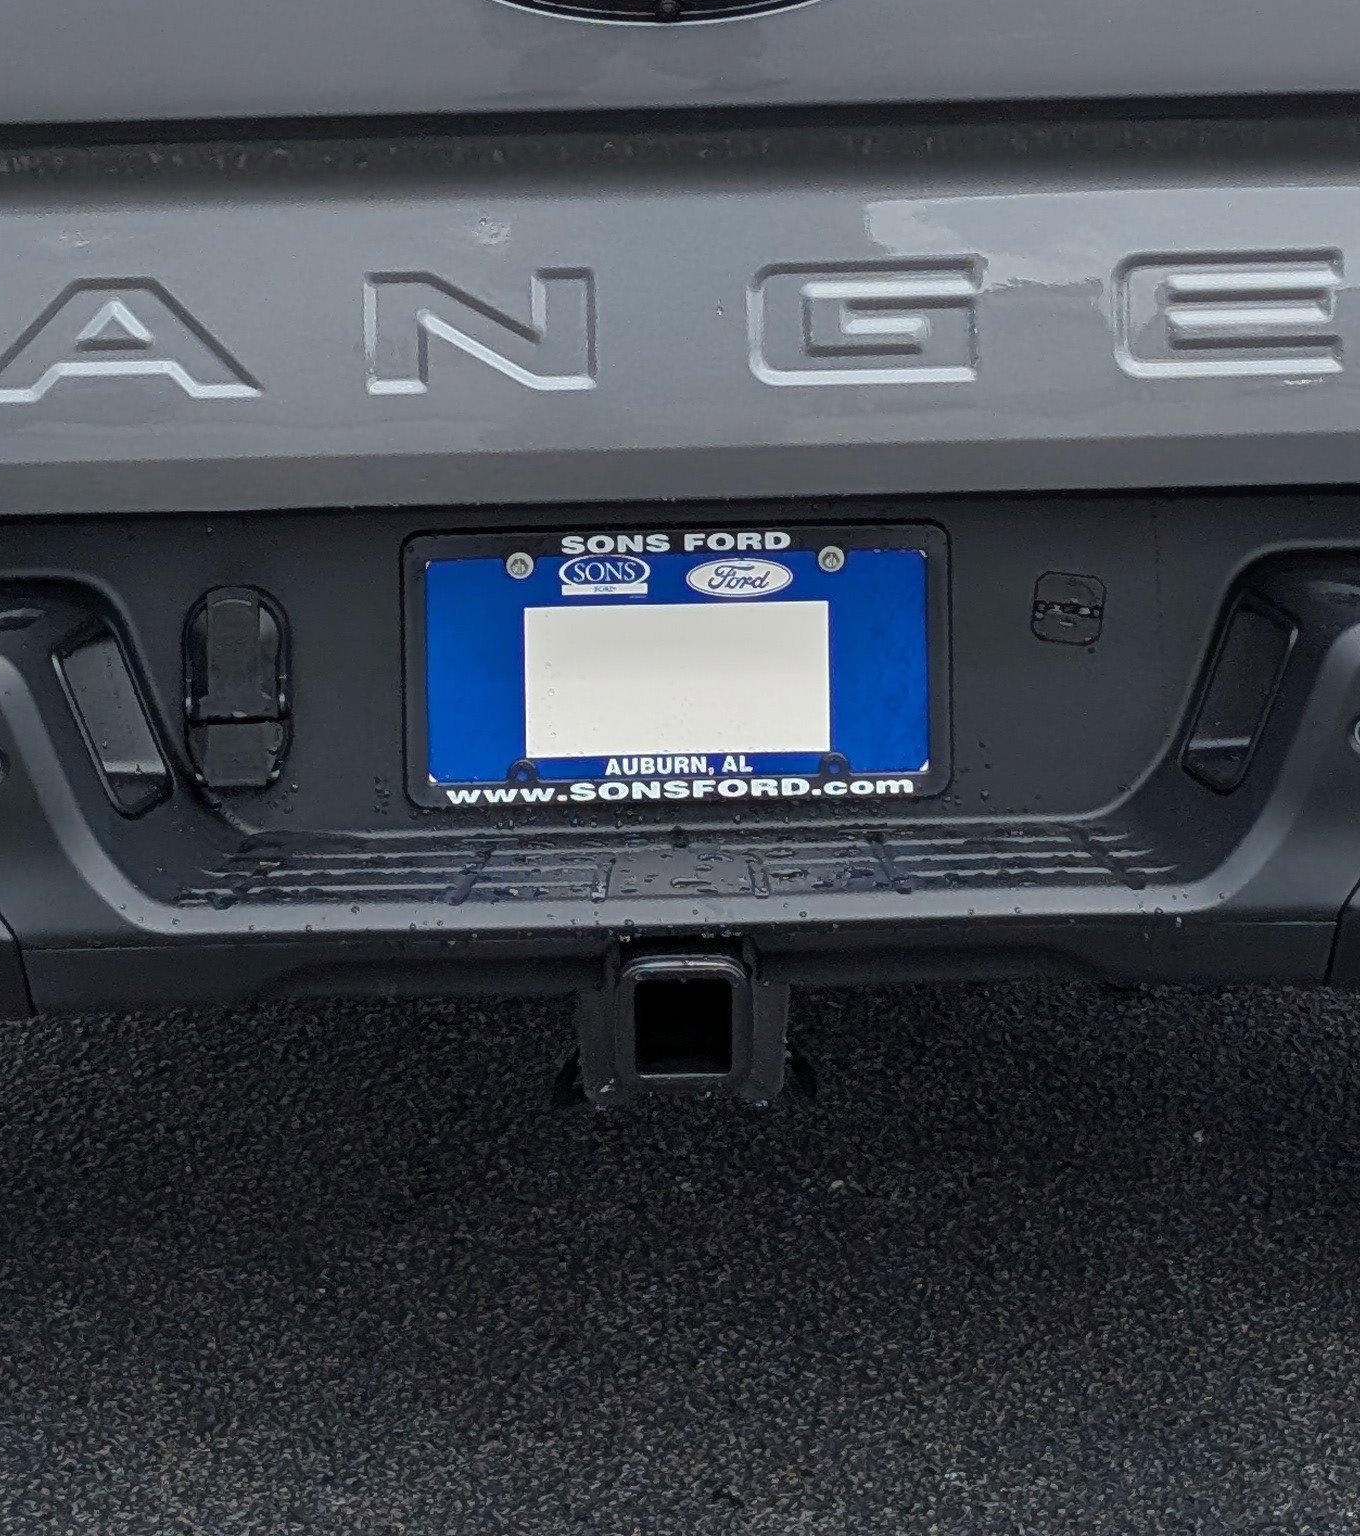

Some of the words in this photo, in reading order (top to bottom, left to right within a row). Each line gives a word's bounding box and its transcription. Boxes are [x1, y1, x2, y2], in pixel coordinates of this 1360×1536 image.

[561, 534, 670, 556] SONS
[684, 532, 792, 552] FORD
[573, 562, 637, 583] SONS
[707, 565, 770, 590] Ford
[604, 757, 714, 776] AUBURN,
[721, 757, 754, 773] AL
[447, 777, 915, 805] www.SONSFORD.com
